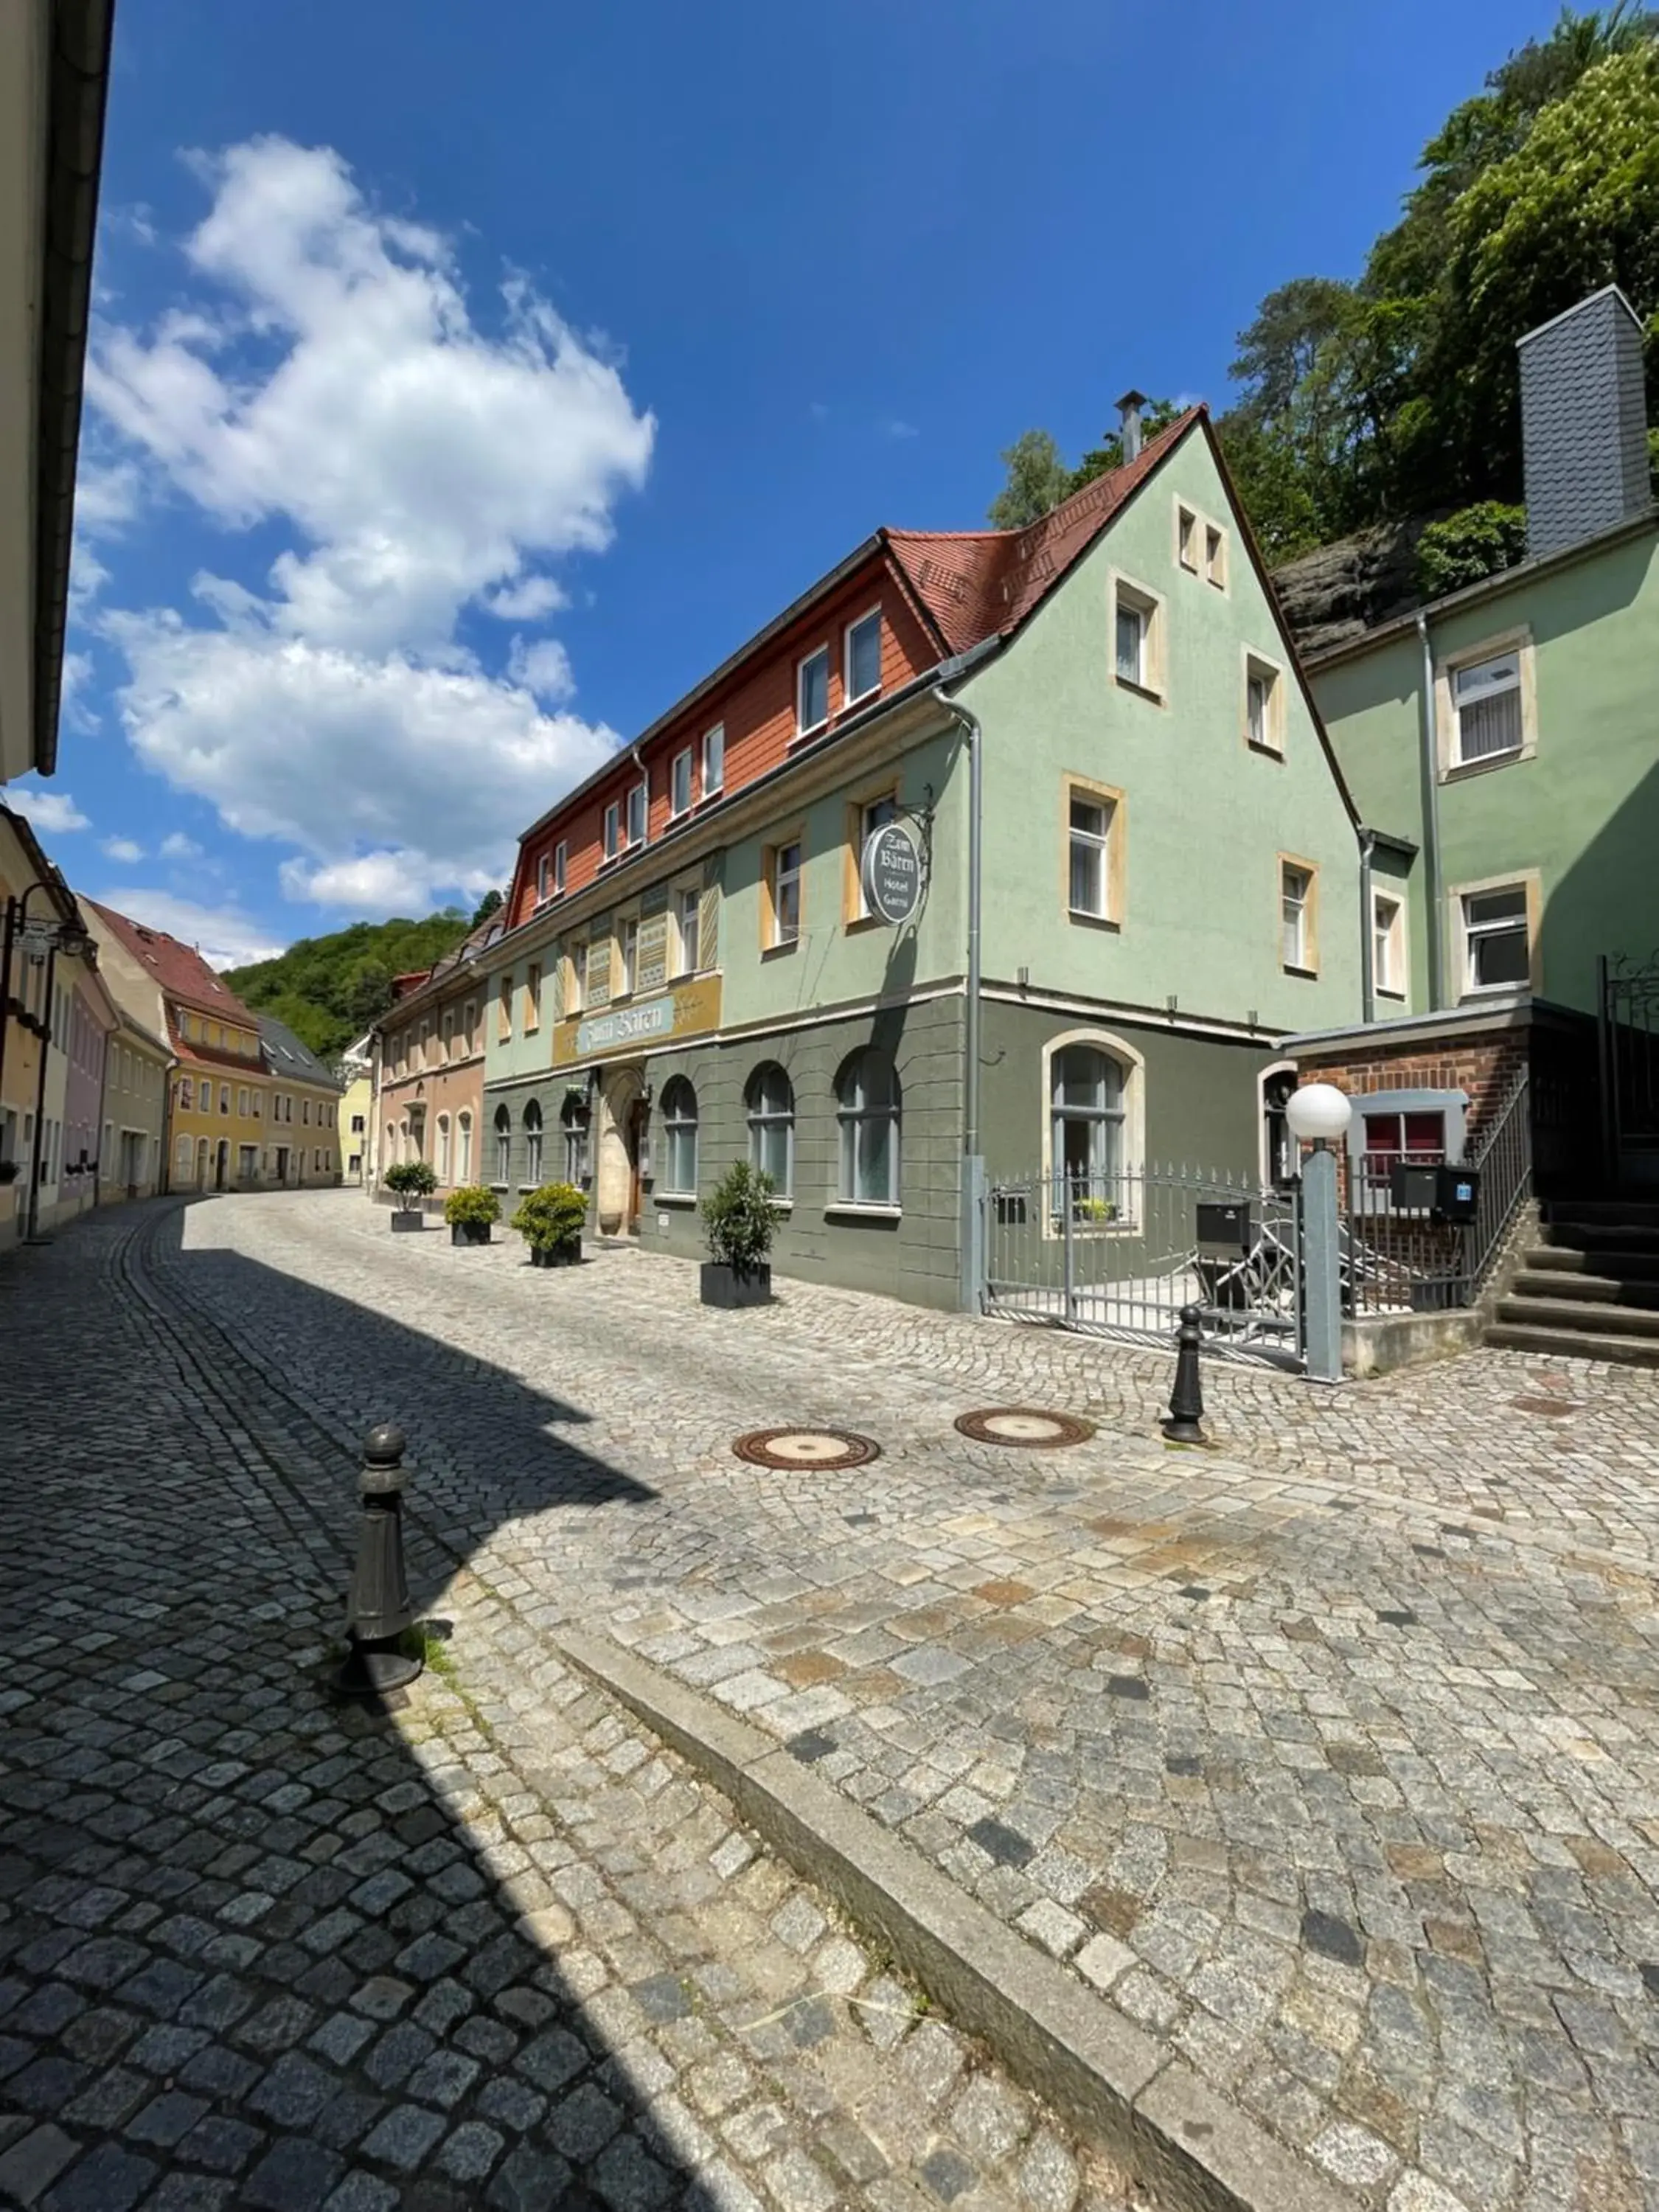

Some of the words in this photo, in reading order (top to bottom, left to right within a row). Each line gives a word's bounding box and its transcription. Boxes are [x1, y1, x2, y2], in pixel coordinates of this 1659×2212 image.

[880, 849, 914, 873] Bären
[883, 877, 908, 893] Hotel
[617, 1009, 661, 1037] Bären
